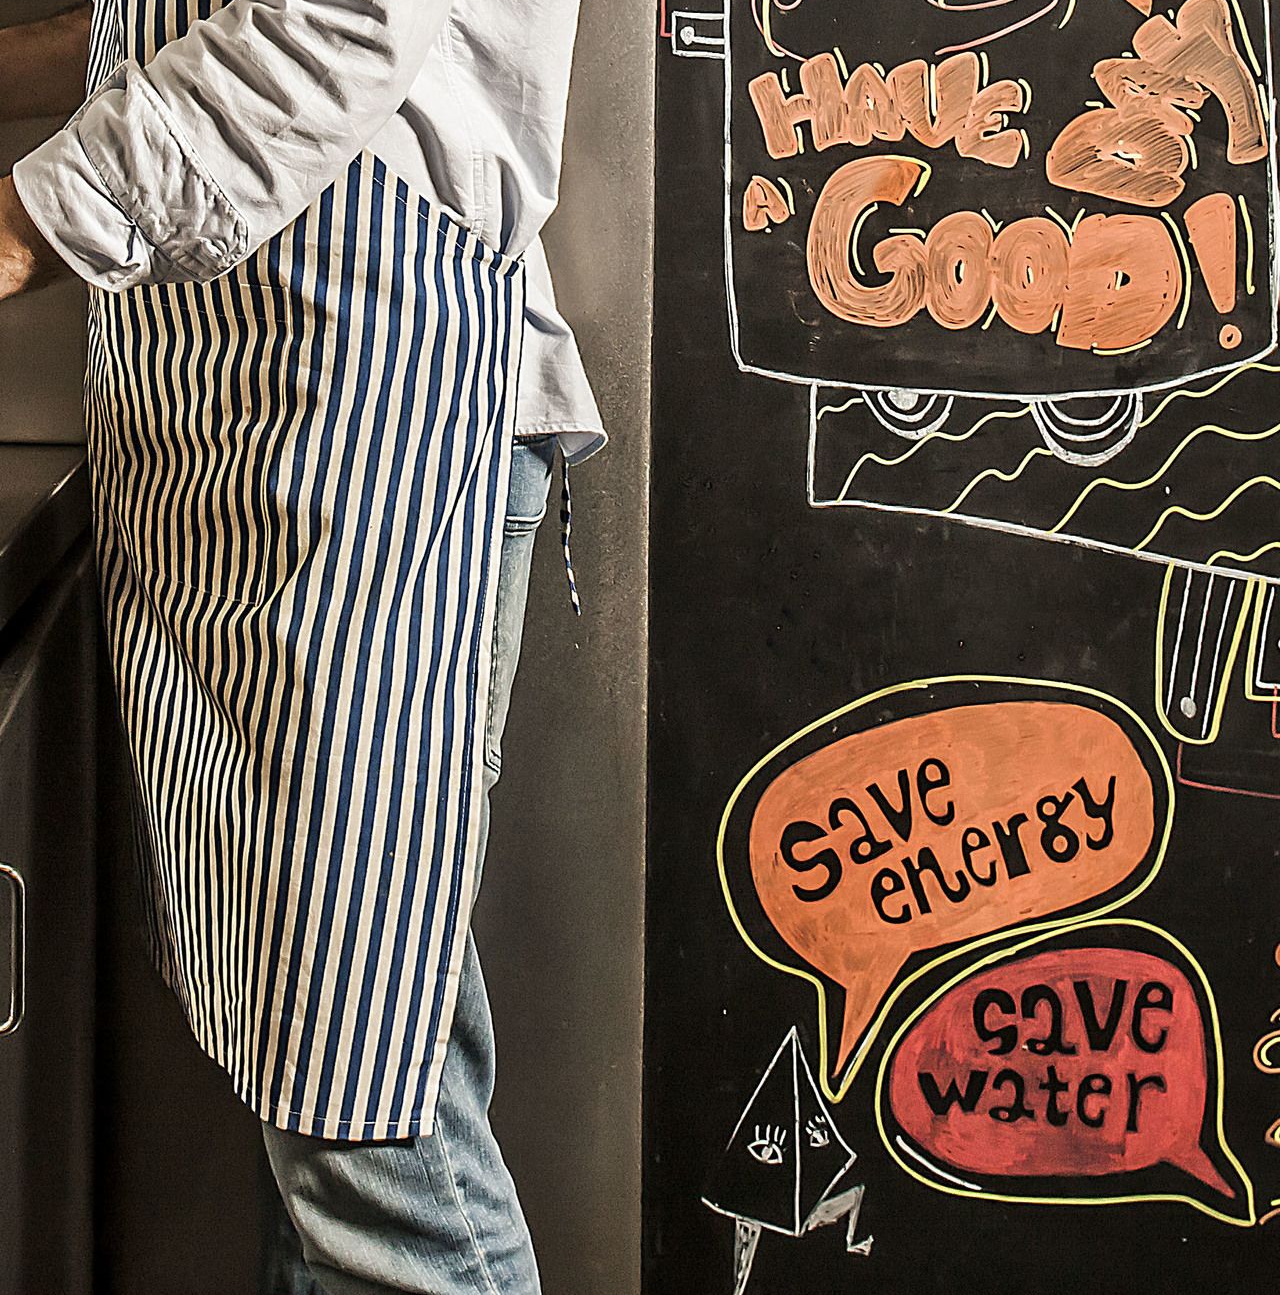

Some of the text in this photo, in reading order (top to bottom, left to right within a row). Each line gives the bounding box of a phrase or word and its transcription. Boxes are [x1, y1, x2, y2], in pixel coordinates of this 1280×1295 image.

[747, 52, 1025, 168] HAVE
[870, 775, 1118, 925] energy
[917, 1064, 1169, 1134] water
